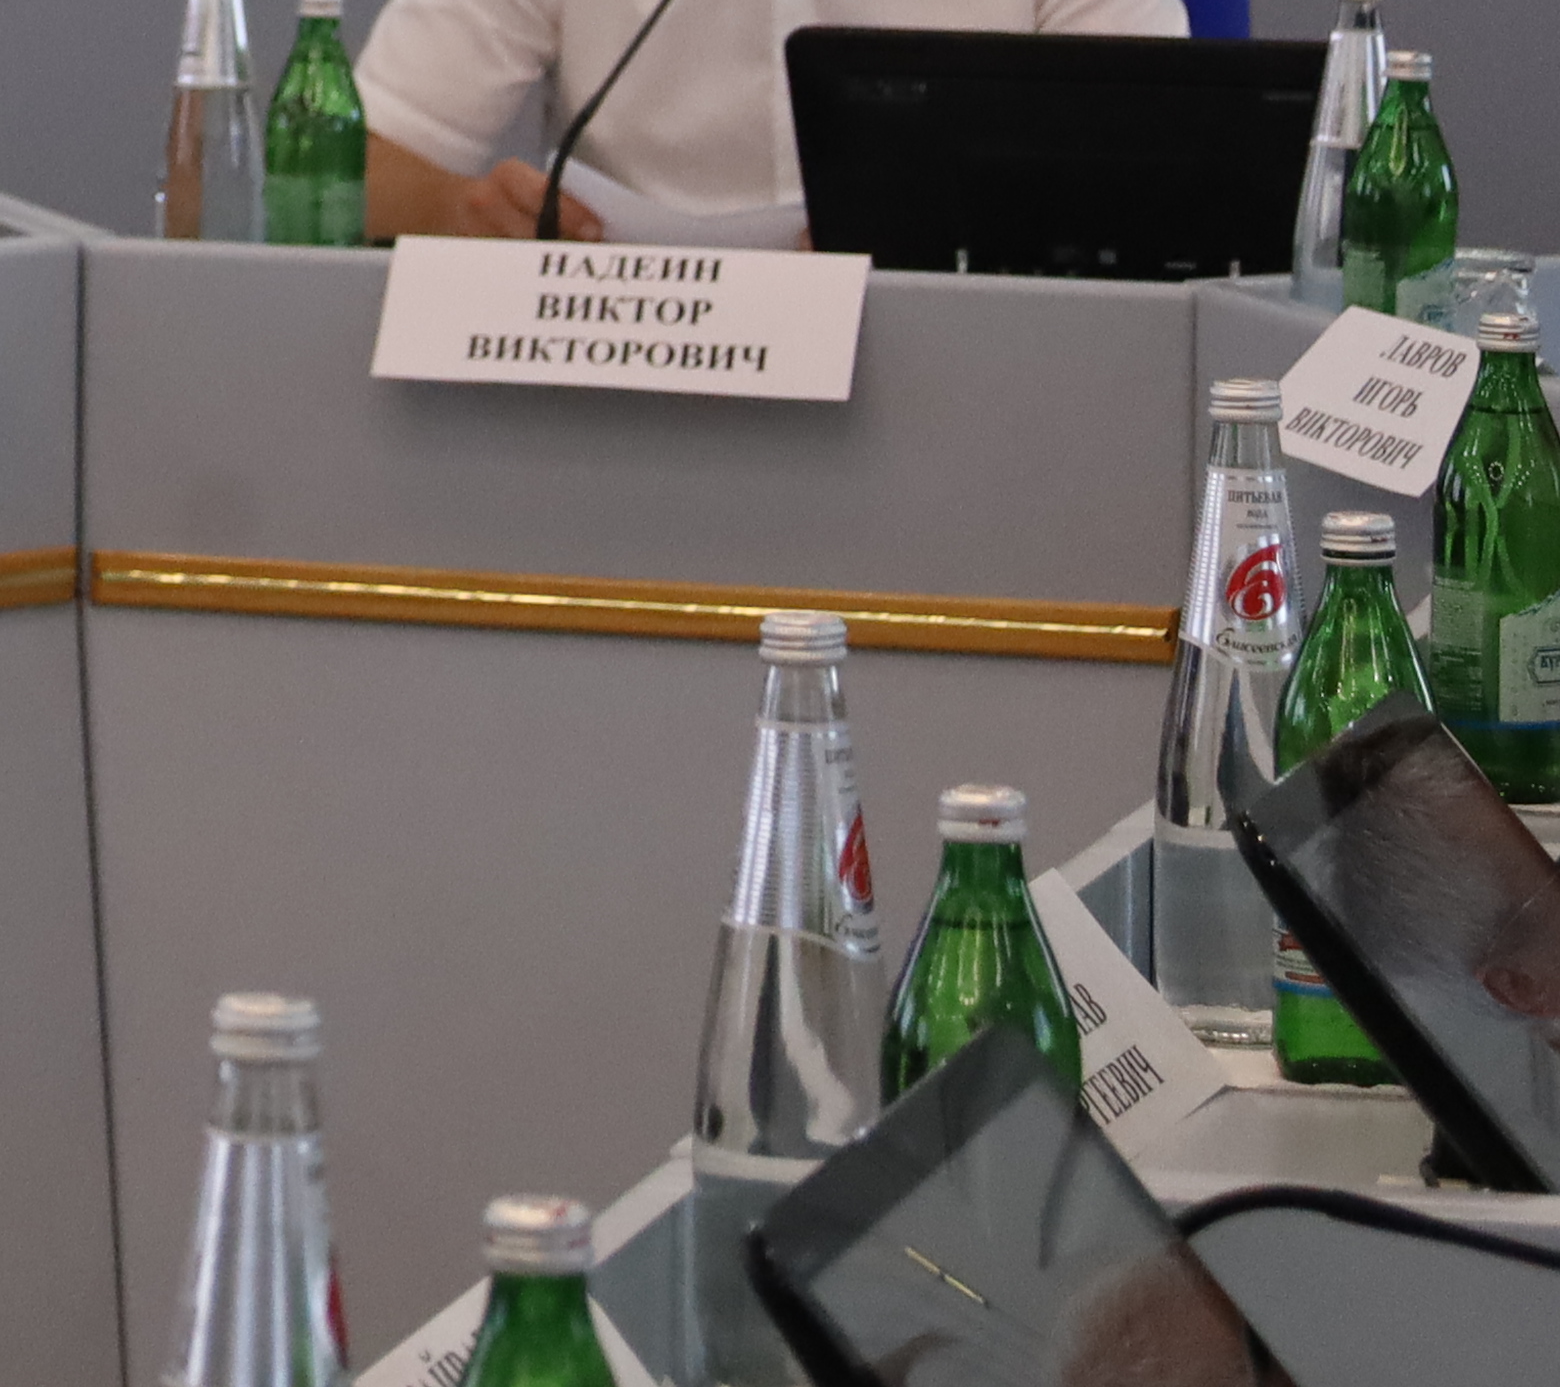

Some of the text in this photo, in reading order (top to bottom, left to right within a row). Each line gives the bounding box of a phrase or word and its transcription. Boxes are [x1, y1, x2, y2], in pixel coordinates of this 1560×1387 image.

[539, 252, 722, 284] НАДЕИН
[536, 293, 713, 327] ВИКТОР
[466, 334, 769, 373] ВИКТОРОВИЧ
[1379, 335, 1466, 378] ЛАВРОВ
[1353, 376, 1425, 419] ИГОРЬ
[1285, 407, 1425, 470] ВИКТОРОВИЧ
